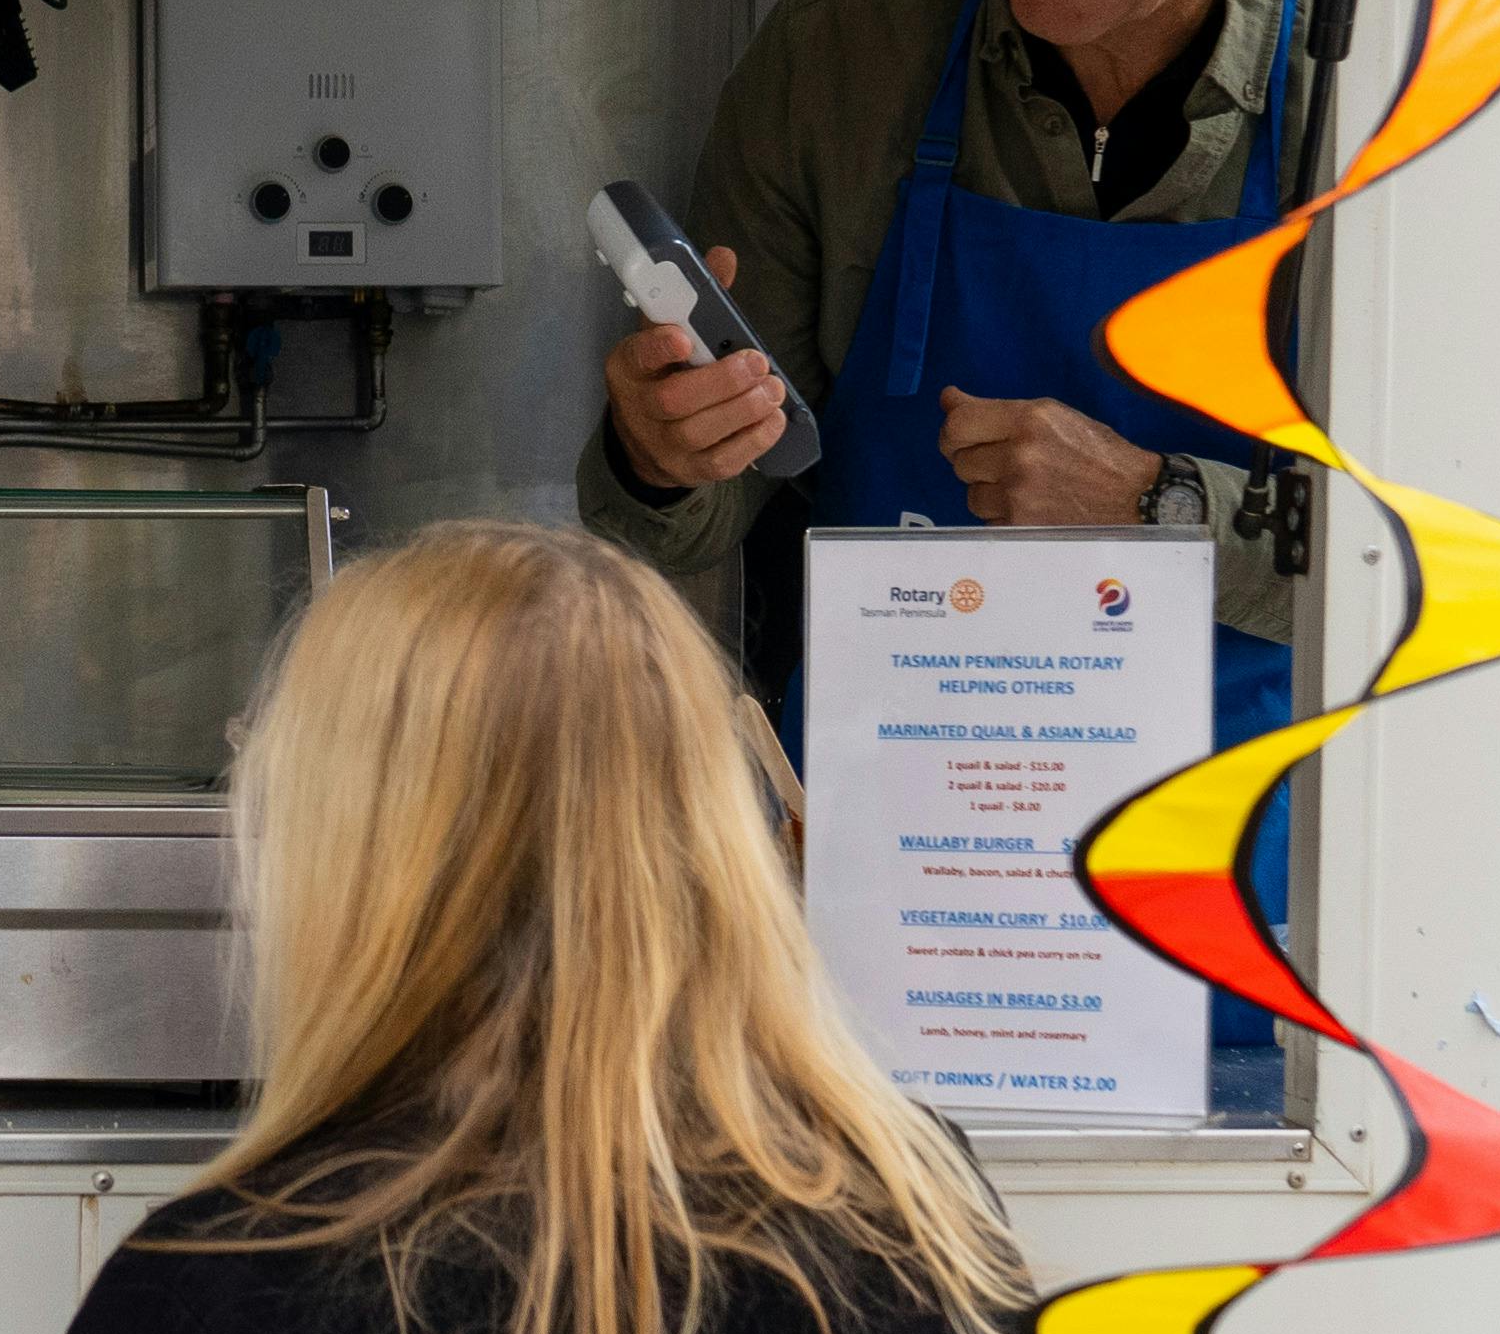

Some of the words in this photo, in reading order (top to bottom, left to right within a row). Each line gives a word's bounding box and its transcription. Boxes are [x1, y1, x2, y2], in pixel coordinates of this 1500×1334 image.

[890, 587, 945, 605] Rotary
[892, 654, 960, 668] TASMAN
[966, 655, 1055, 669] PENINSULA
[1060, 656, 1123, 670] ROTARY
[939, 680, 1007, 694] HELPING
[1012, 681, 1074, 695] OTHERS
[878, 724, 966, 738] MARINATED
[972, 725, 1017, 739] QUAIL
[1021, 725, 1032, 738] &
[1038, 726, 1083, 739] ASIAN
[1088, 727, 1135, 740] SALAD
[900, 836, 969, 850] WALLABY
[973, 837, 1034, 851] BURGER
[901, 911, 993, 925] VEGETARIAN
[999, 912, 1047, 927] CURRY
[907, 990, 982, 1006] SAUSAGES
[987, 992, 1003, 1006] IN
[1008, 993, 1057, 1007] BREAD
[1061, 995, 1101, 1011] $3.00
[934, 1072, 993, 1087] DRINKS
[999, 1073, 1006, 1089] /
[1011, 1073, 1067, 1090] WATER
[1072, 1075, 1116, 1092] $2.00
